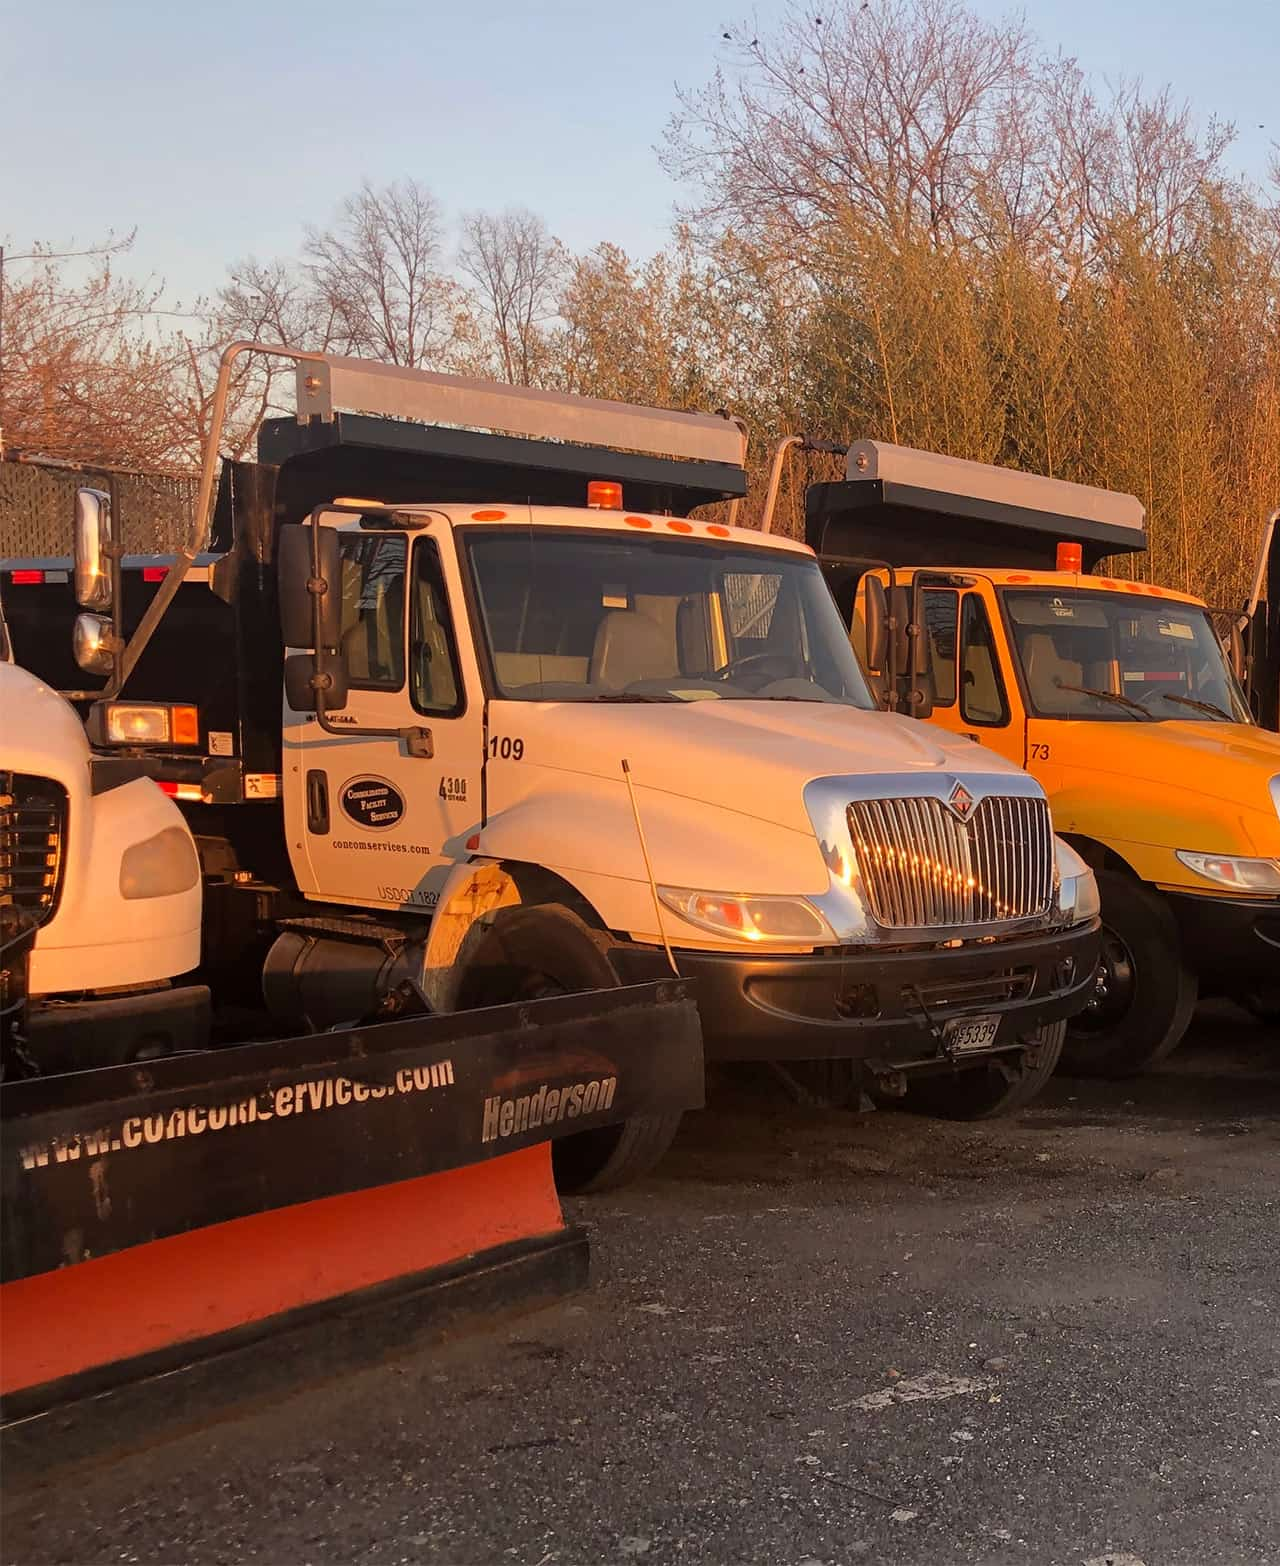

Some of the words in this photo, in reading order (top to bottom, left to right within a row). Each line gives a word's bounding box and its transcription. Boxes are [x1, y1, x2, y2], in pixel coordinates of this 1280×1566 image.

[490, 735, 524, 760] 109
[1031, 744, 1049, 760] 73
[439, 776, 467, 800] 4300
[332, 840, 430, 855] concomservices.com
[377, 886, 415, 903] USDOT
[481, 1076, 617, 1143] Henderson
